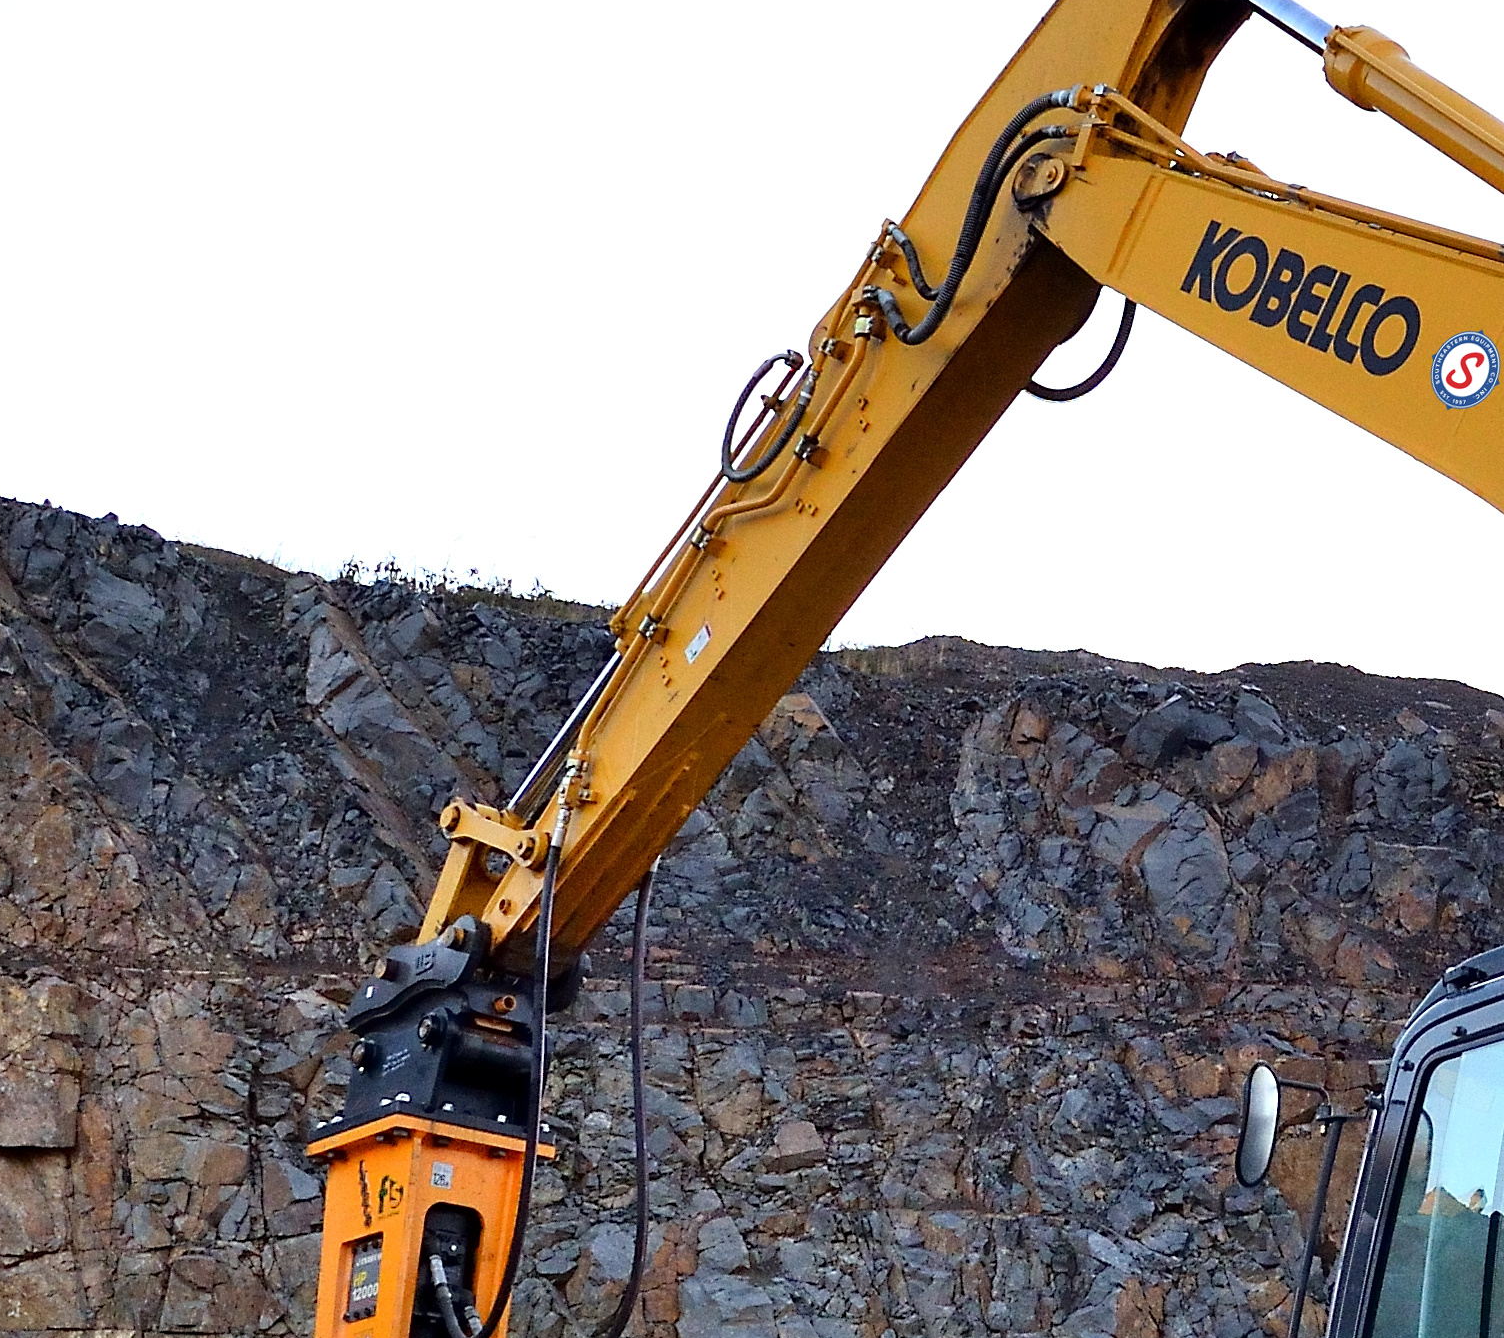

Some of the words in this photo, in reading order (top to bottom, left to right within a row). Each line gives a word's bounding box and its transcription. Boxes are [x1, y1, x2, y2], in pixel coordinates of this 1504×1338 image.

[1180, 220, 1421, 376] KOBELCO
[1434, 335, 1469, 385] SOUTHEASTERN
[1470, 335, 1497, 369] EQUIPMENT
[1445, 352, 1485, 389] S
[352, 1282, 379, 1302] 12000
